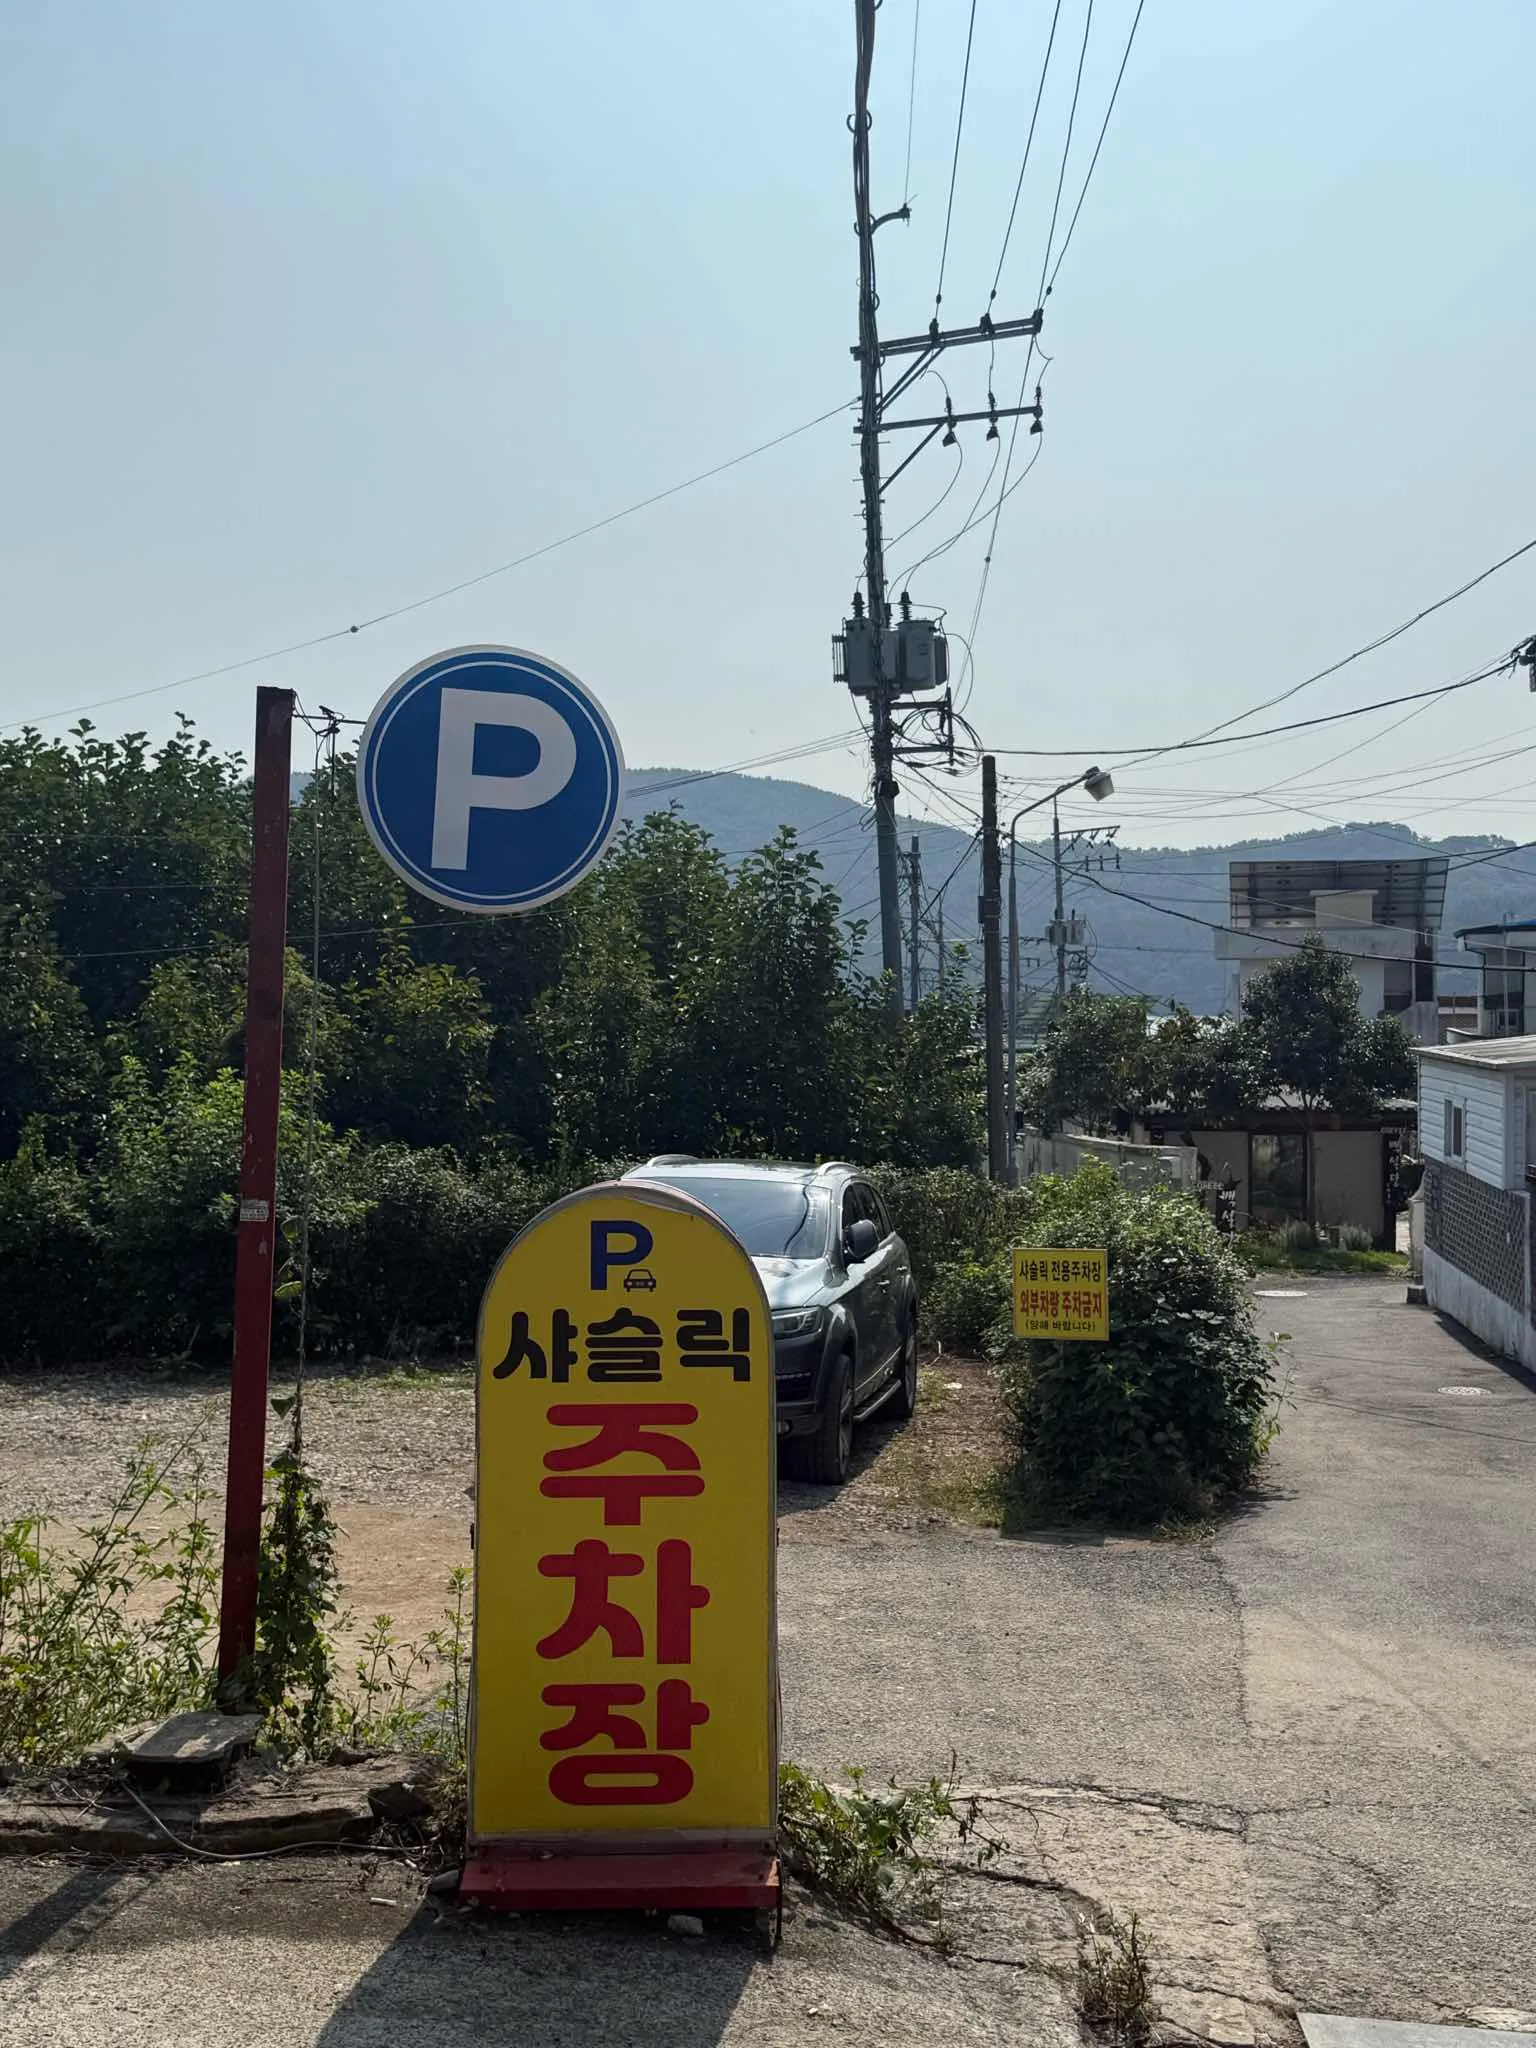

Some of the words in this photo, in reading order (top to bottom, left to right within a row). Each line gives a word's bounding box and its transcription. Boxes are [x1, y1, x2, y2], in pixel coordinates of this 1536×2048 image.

[431, 687, 576, 870] P
[590, 1220, 654, 1291] P
[1051, 1260, 1101, 1282] 전용주차장
[1020, 1288, 1059, 1317] 외부차량
[1062, 1289, 1102, 1319] 주차금지
[492, 1307, 751, 1383] 샤슬릭
[535, 1403, 711, 1807] 주차장
